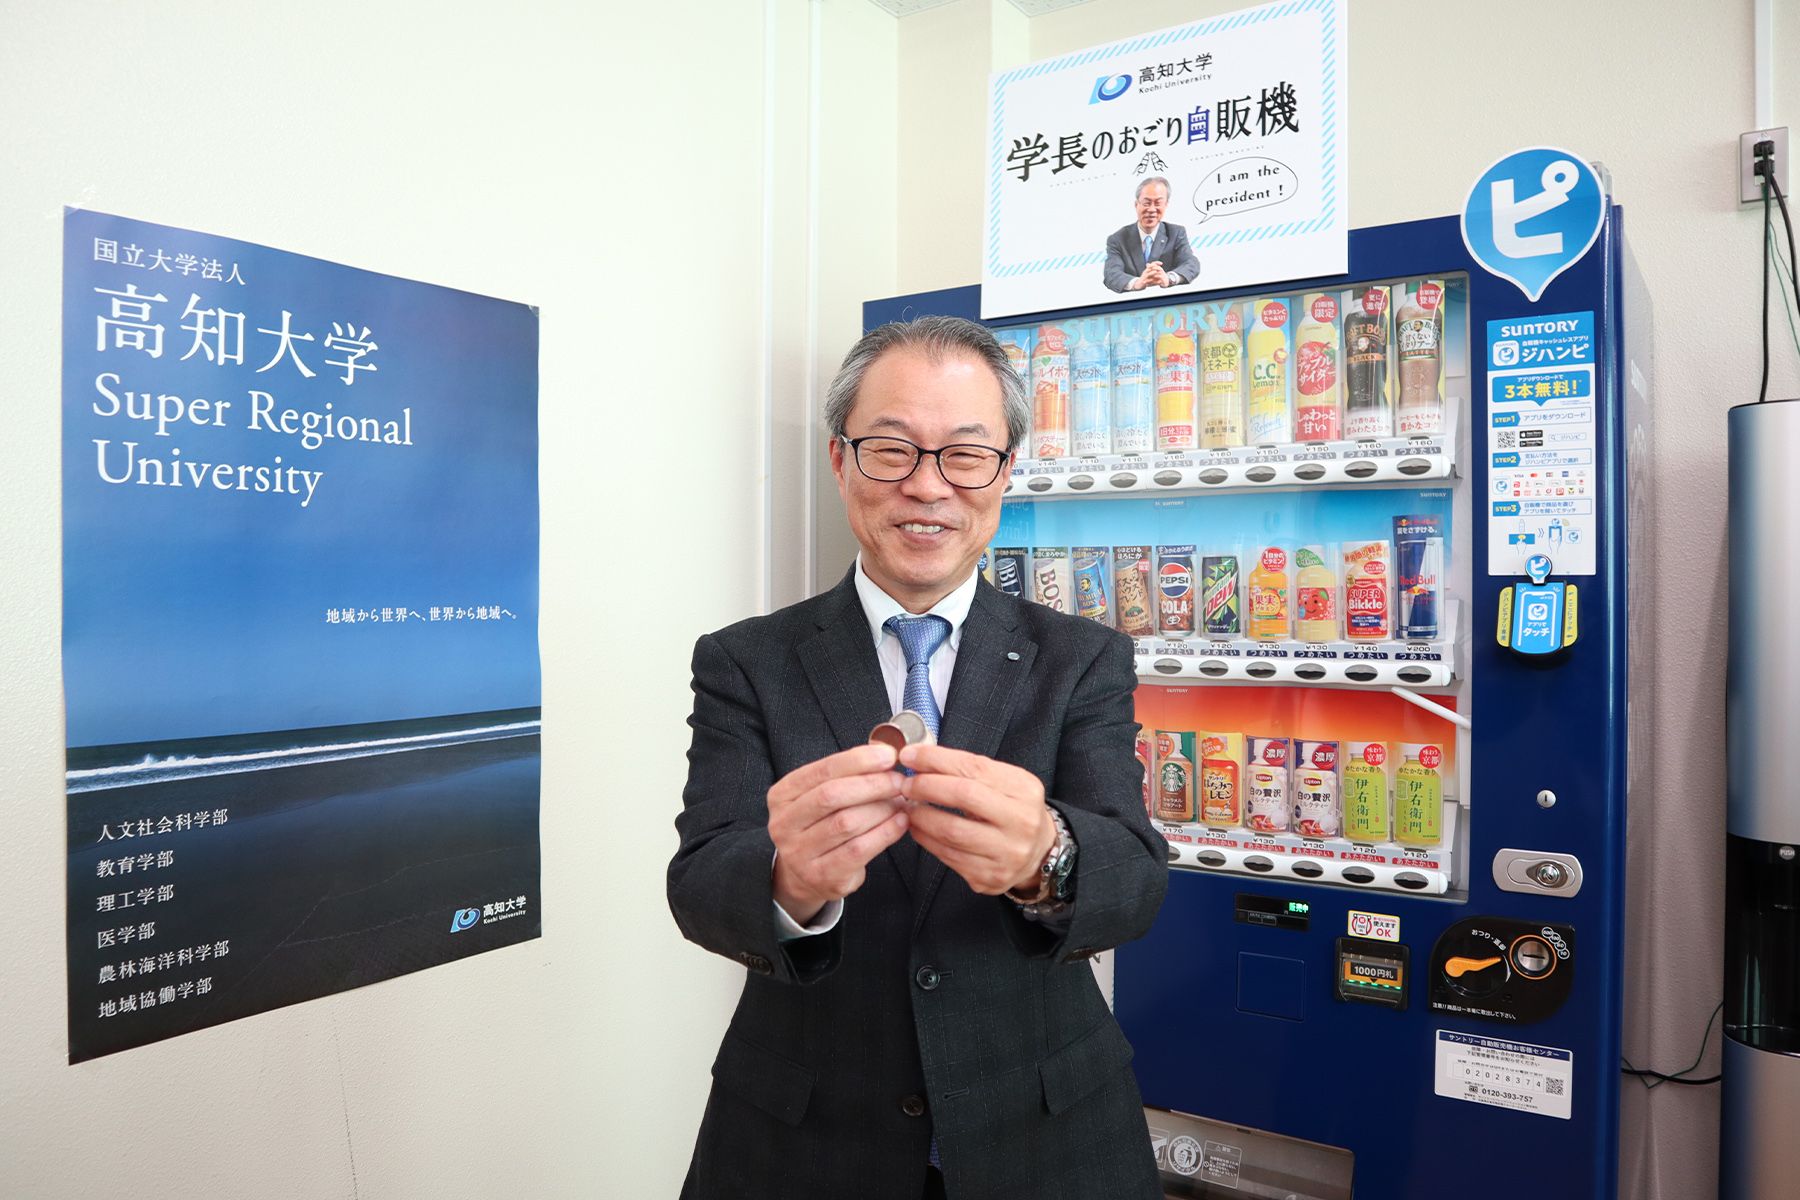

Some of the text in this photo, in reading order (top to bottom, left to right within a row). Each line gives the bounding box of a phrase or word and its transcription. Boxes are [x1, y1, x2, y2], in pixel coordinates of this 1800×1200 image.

[1138, 51, 1213, 84] 高知大学
[1138, 72, 1213, 95] Kochi University
[1006, 81, 1299, 182] 学長のおごり自販機
[1216, 165, 1280, 184] I am the
[1206, 185, 1284, 211] president !
[1491, 160, 1579, 259] ピ
[94, 237, 246, 286] 国立大学法人
[1314, 308, 1335, 318] 限定
[95, 284, 378, 385] 高知大学
[1501, 320, 1579, 338] SUNTORY
[1522, 344, 1589, 362] ジハンピ
[1253, 363, 1280, 380] C.C.
[93, 372, 413, 450] Super Regional
[1298, 409, 1336, 422] しゅわっと
[1524, 412, 1586, 421] アプリをダウンロード
[1304, 423, 1327, 434] 甘い
[93, 440, 323, 507] University
[1161, 576, 1189, 584] PEPSI
[1400, 575, 1436, 585] Red Bull
[1350, 589, 1380, 599] SUPER
[1161, 600, 1188, 614] COLA
[1348, 599, 1383, 610] Bikkle
[326, 606, 517, 623] 地域から世界へ、世界から地域へ。
[1523, 627, 1550, 637] タッチ
[1266, 748, 1286, 759] 濃厚
[1315, 751, 1335, 762] 濃厚
[1366, 753, 1385, 763] 京都
[1422, 755, 1440, 766] 京都
[1345, 766, 1381, 774] ゆたかな香り
[1398, 767, 1437, 776] ゆたかな香り
[1204, 780, 1233, 791] はちみつ
[1210, 790, 1232, 800] レモン
[1250, 787, 1282, 798] 白の贅沢
[1297, 791, 1331, 802] 白の贅沢
[1356, 778, 1369, 830] 伊右衛門
[1409, 780, 1424, 834] 伊右衛門
[97, 808, 228, 843] 人文社会科学部
[1199, 838, 1237, 847] あたたかい
[1246, 843, 1284, 852] あたたかい
[1294, 848, 1333, 858] あたたかい
[1352, 846, 1376, 854] ¥120
[1404, 851, 1429, 859] ¥120
[96, 850, 174, 878] 教育学部
[1344, 853, 1384, 862] あたたかい
[1396, 858, 1437, 869] あたたかい
[96, 884, 174, 913] 理工学部
[483, 895, 527, 918] 高知大学
[1288, 902, 1309, 913] 販売中
[483, 909, 526, 924] Kochi University
[1373, 921, 1396, 929] 使えます
[98, 921, 155, 949] 医学部
[1376, 928, 1392, 938] OK
[98, 939, 230, 984] 農林海洋科学部
[1354, 965, 1394, 980] 1000円札
[98, 976, 213, 1019] 地域協働学部
[1448, 1034, 1560, 1057] サントリー自動販売機お客様センター
[1481, 1088, 1534, 1104] 0120-393-757
